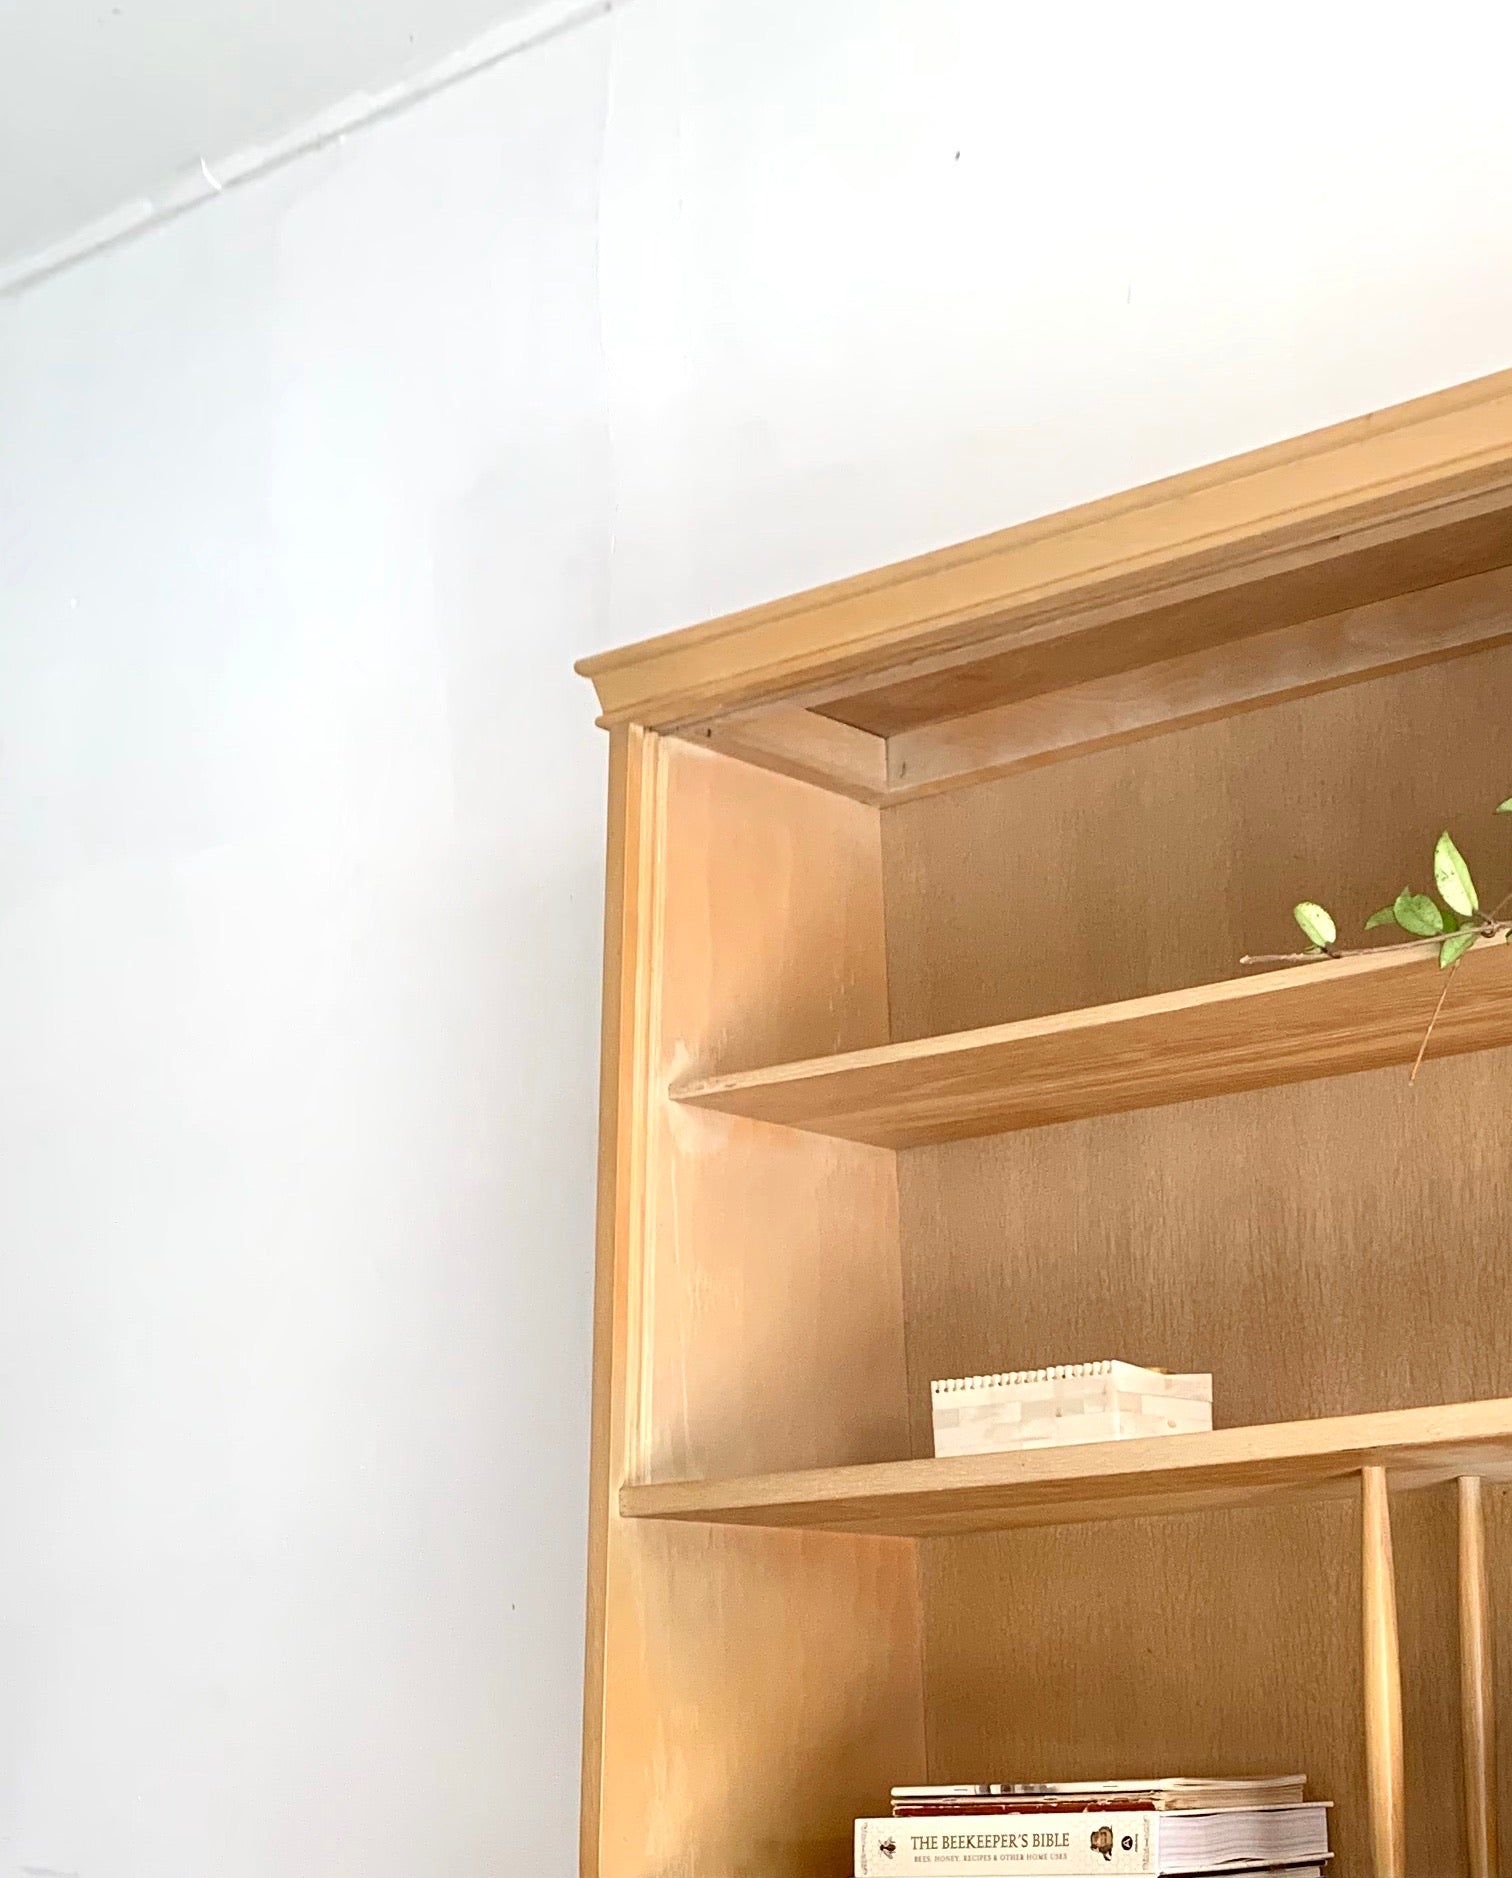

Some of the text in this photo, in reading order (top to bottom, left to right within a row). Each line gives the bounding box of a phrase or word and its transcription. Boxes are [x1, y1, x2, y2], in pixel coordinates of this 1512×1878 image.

[911, 1832, 1070, 1850] THE BEEKEEPER'S BIBLE
[963, 1854, 991, 1862] RECIPES
[999, 1853, 1024, 1861] OTHER
[1026, 1853, 1048, 1861] HOME
